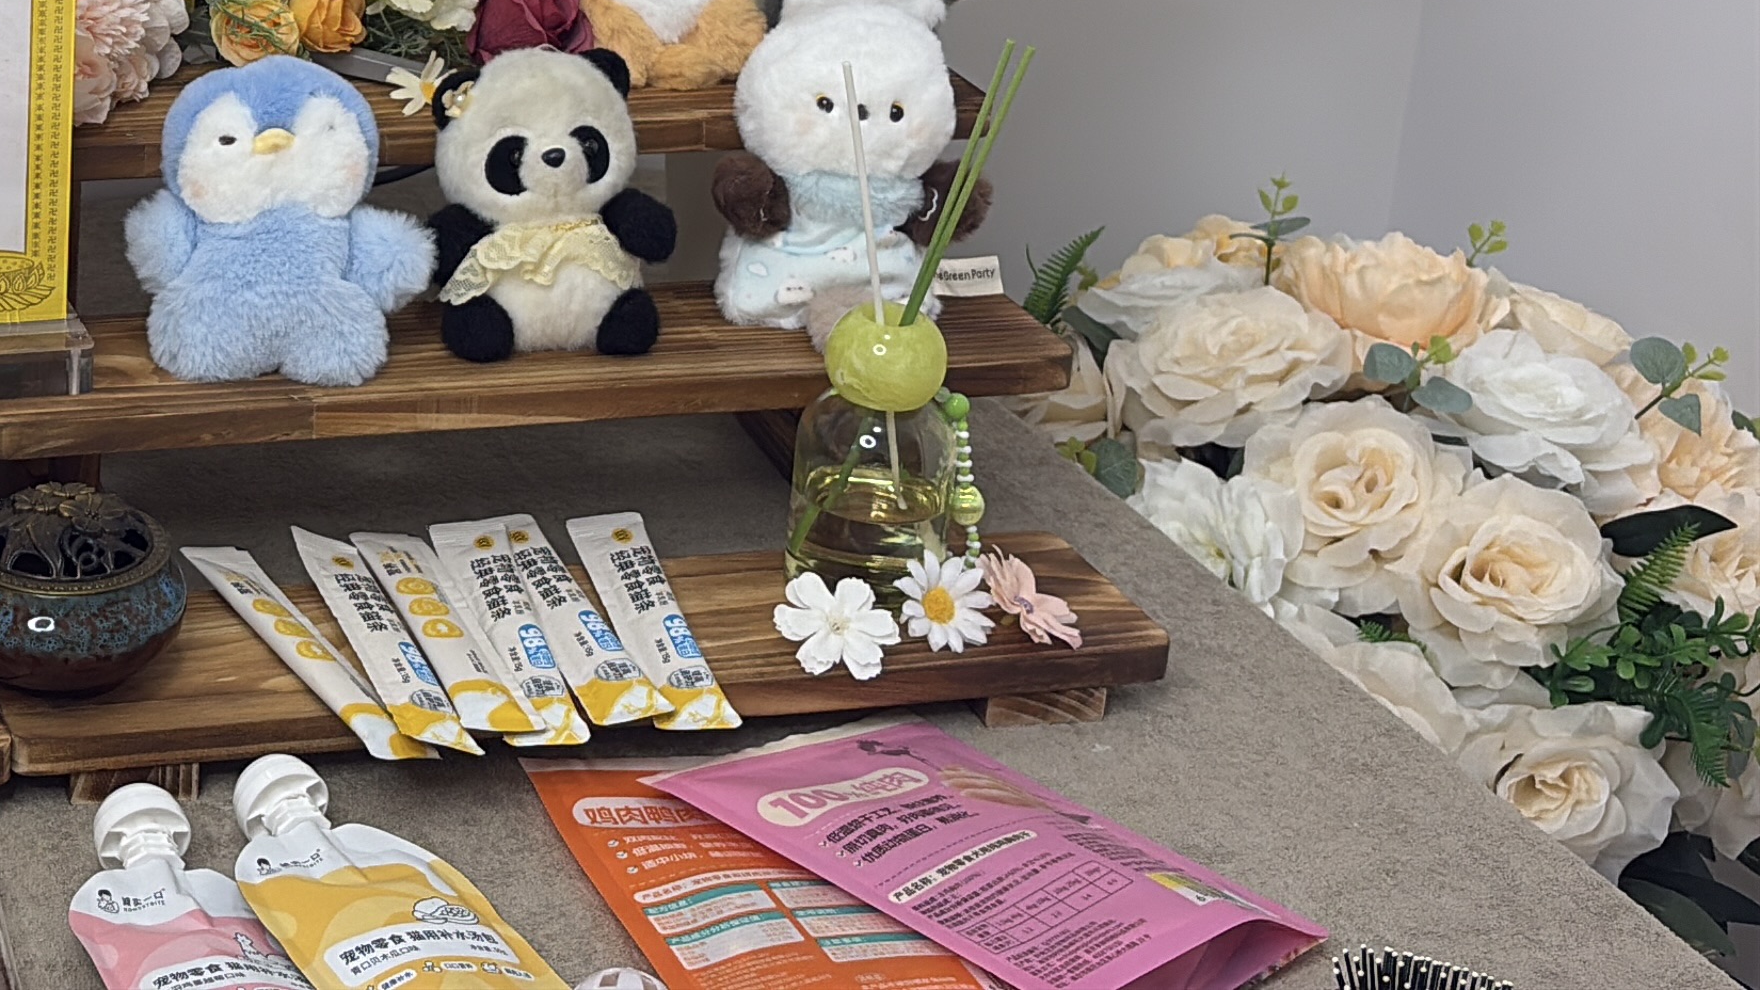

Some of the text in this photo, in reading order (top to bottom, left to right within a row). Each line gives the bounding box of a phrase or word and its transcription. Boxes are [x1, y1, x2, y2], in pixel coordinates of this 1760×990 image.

[339, 934, 407, 965] 宠物零食
[152, 963, 224, 990] 宠物零食
